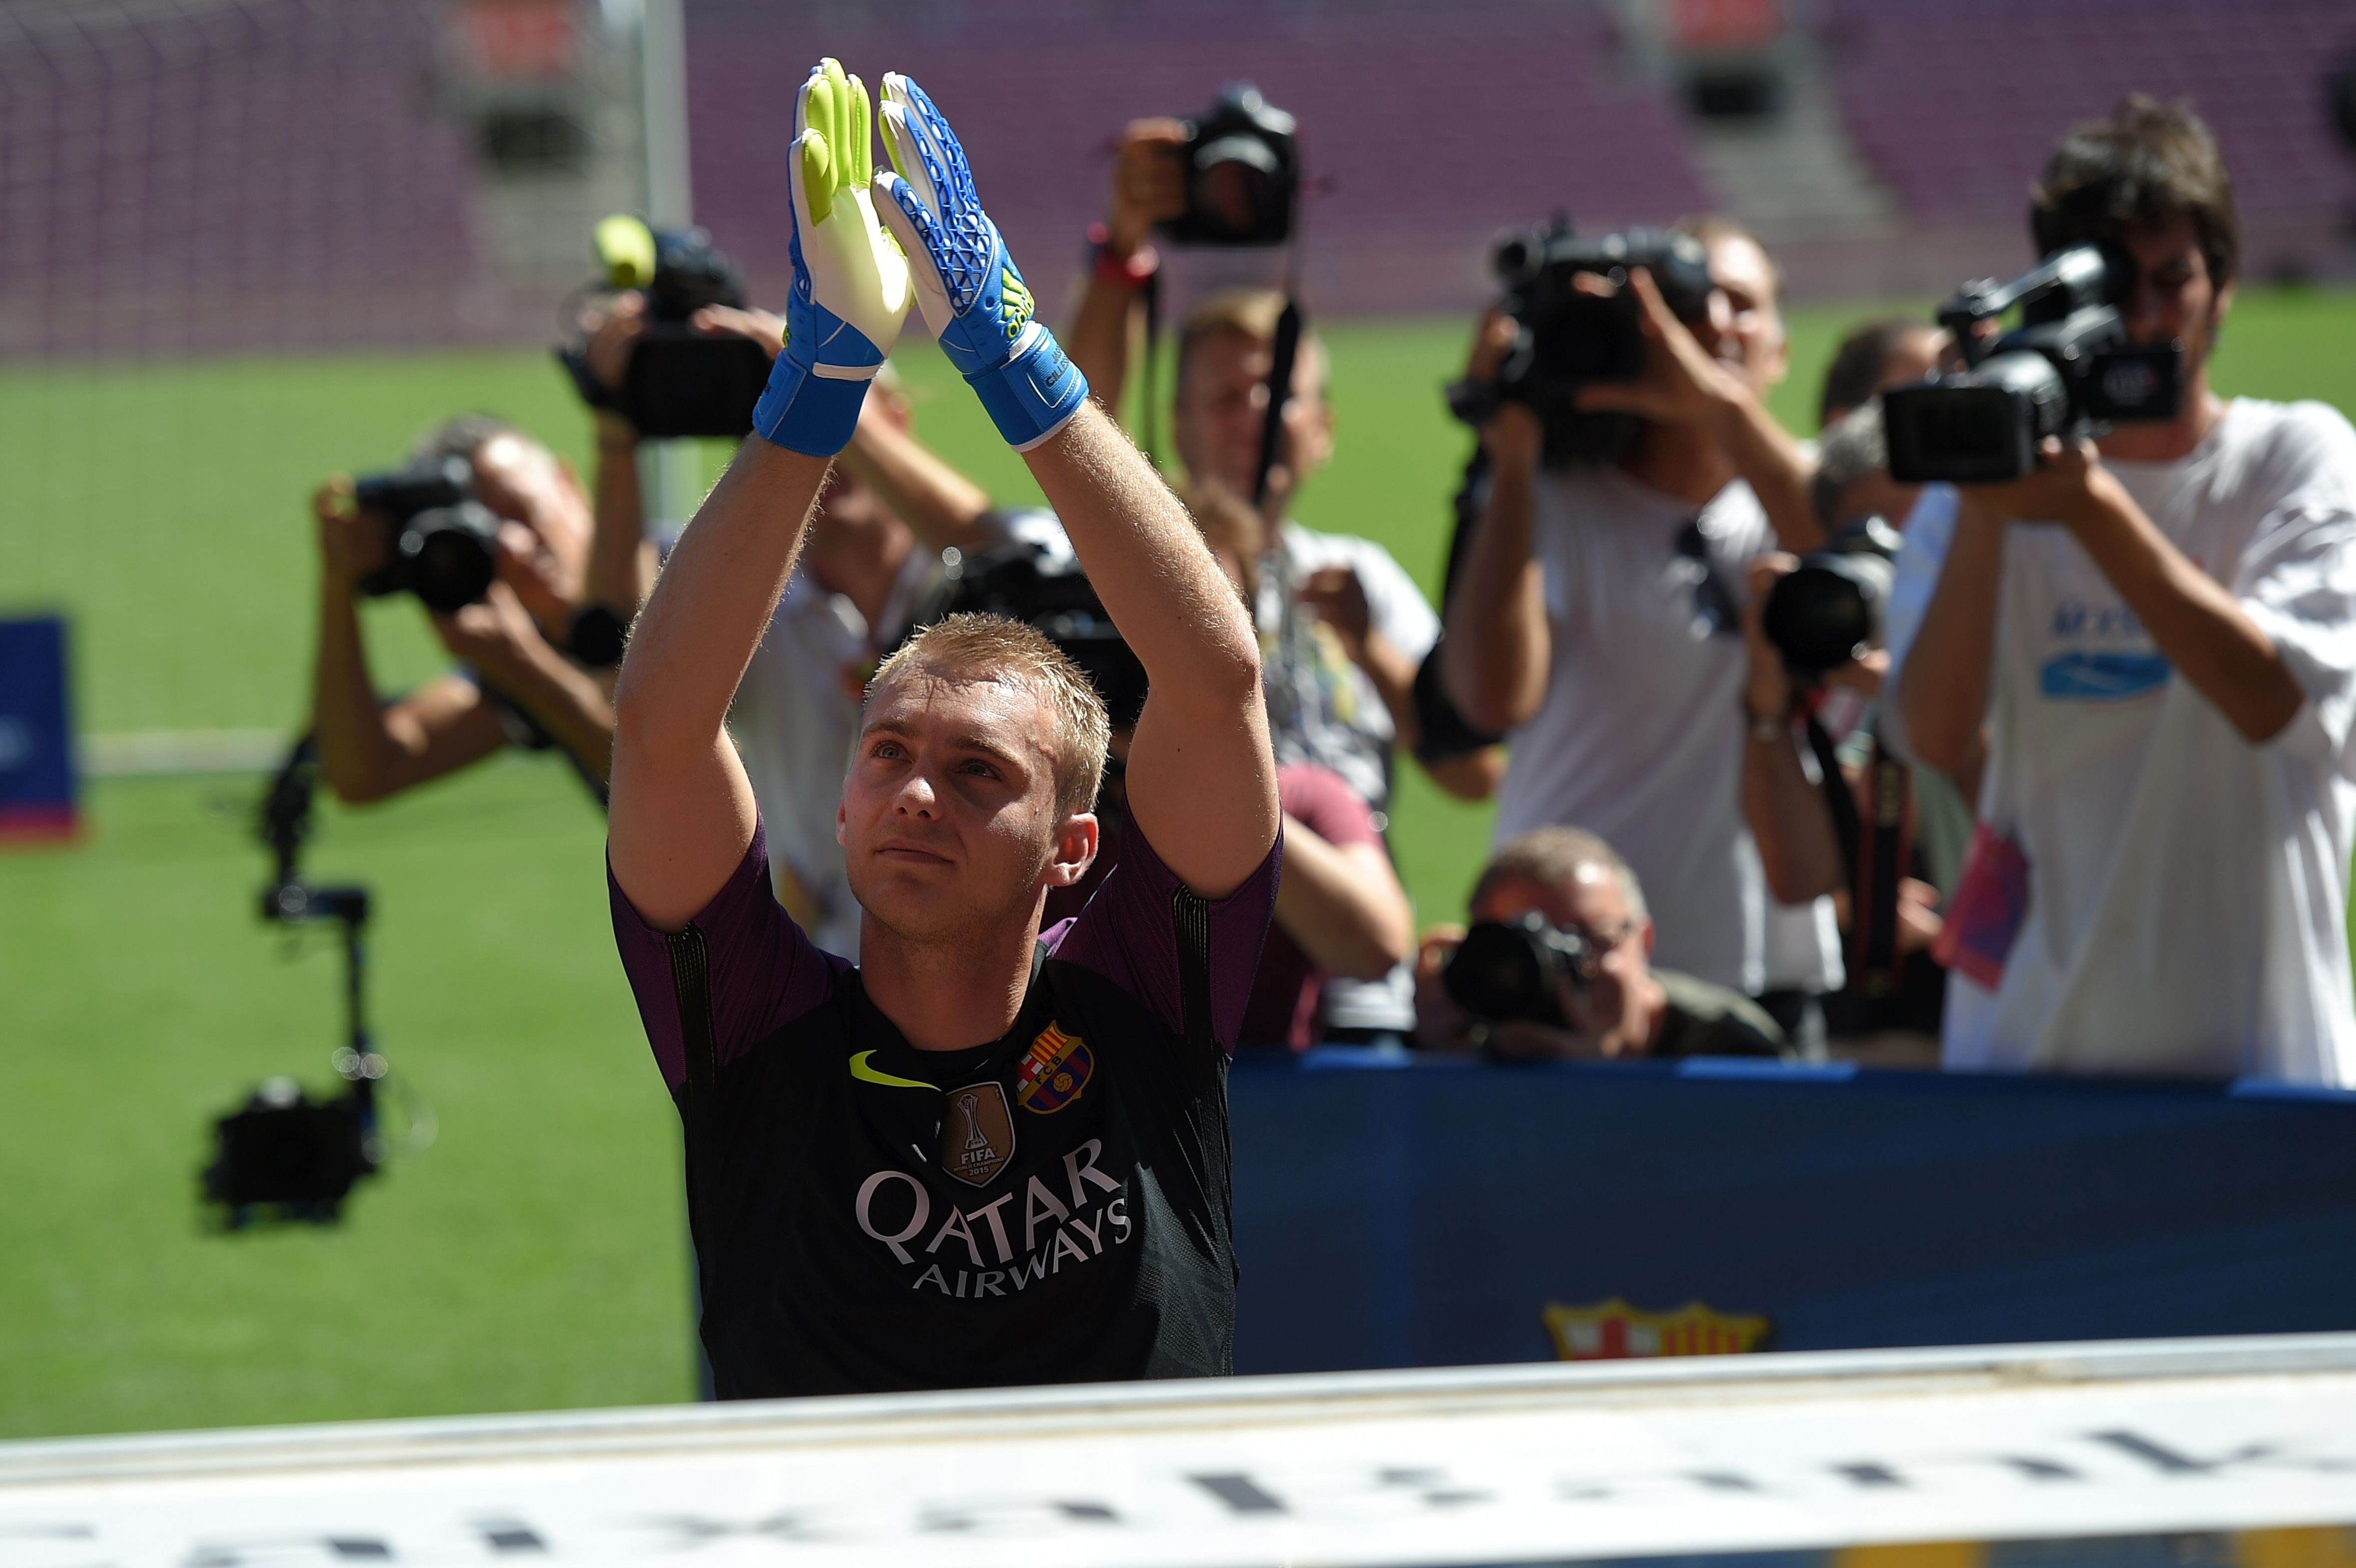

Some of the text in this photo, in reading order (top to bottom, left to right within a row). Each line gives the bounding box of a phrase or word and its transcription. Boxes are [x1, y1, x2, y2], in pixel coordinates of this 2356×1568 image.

[1034, 1055, 1062, 1085] FCB
[954, 1156, 1005, 1172] WORLD CHAMPIONS
[968, 1165, 989, 1176] 2015
[855, 1138, 1122, 1267] QATAR
[912, 1198, 1132, 1298] AIRWAYS
